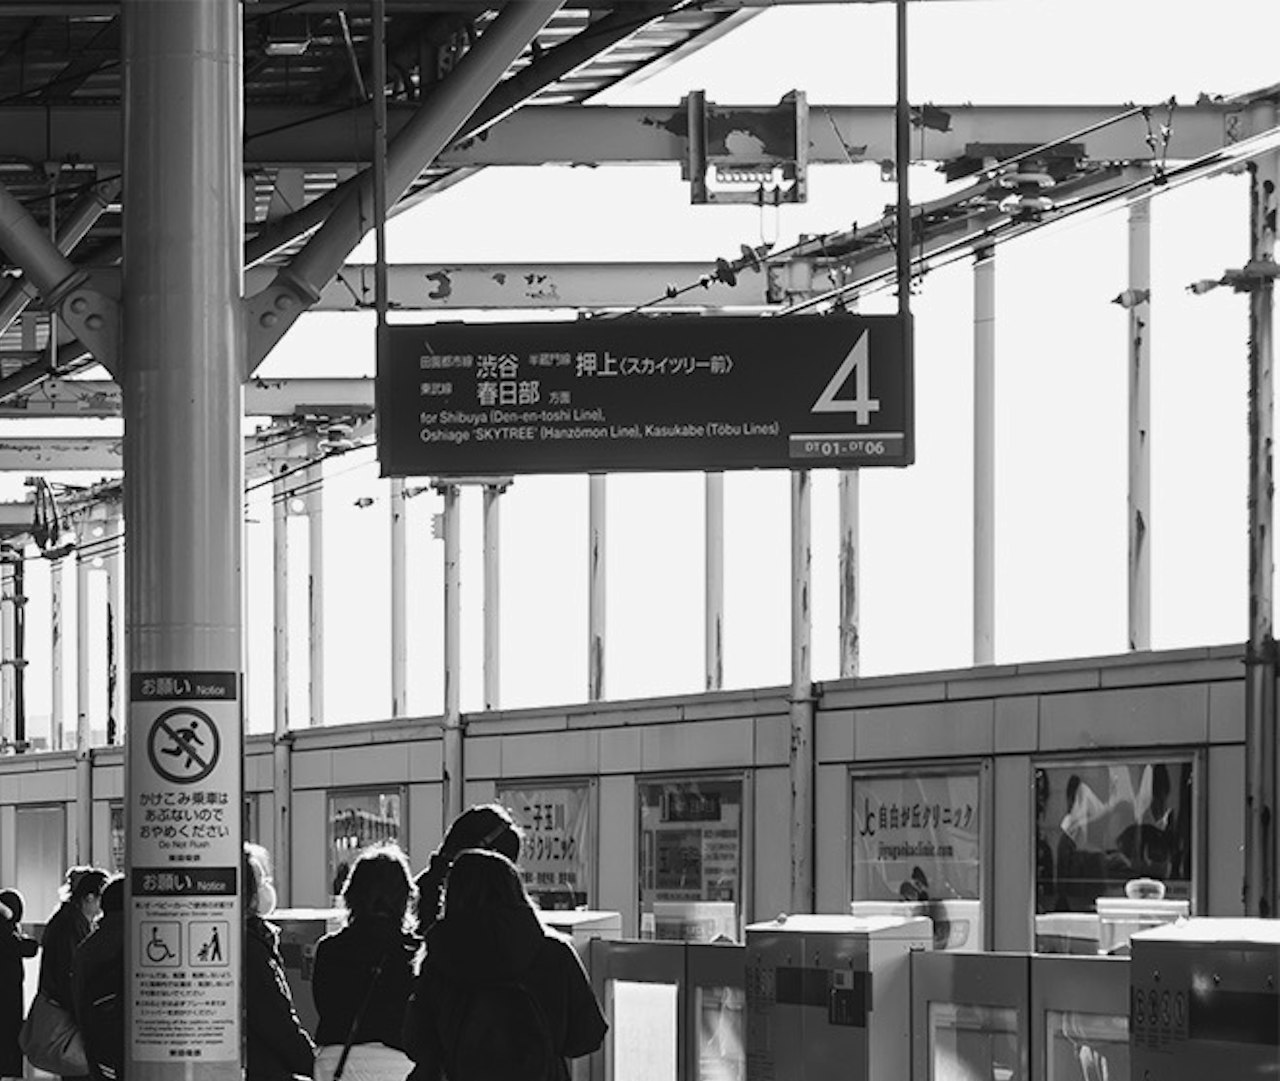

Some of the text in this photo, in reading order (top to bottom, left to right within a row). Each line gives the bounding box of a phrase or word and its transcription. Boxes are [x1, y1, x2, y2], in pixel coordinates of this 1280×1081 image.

[476, 354, 519, 379] 渋谷
[810, 327, 880, 425] 4
[476, 380, 541, 406] 春日部
[548, 391, 571, 405] 方面
[420, 412, 437, 424] for
[439, 410, 488, 425] Shibuya
[490, 409, 571, 423] (Den-en-toshi
[420, 428, 470, 443] Oshiage
[644, 423, 704, 438] Kasukabe
[742, 421, 780, 436] Lines)
[141, 677, 225, 696] お願い Notice
[139, 792, 228, 806] かけこみ乗車は
[145, 808, 223, 822] あぶないので
[523, 804, 565, 831] 二子玉川
[879, 803, 972, 829] 自由が丘クリニック
[140, 825, 229, 838] おやめください
[159, 840, 170, 849] Do
[173, 840, 187, 849] Not
[143, 873, 226, 892] お願い Notice
